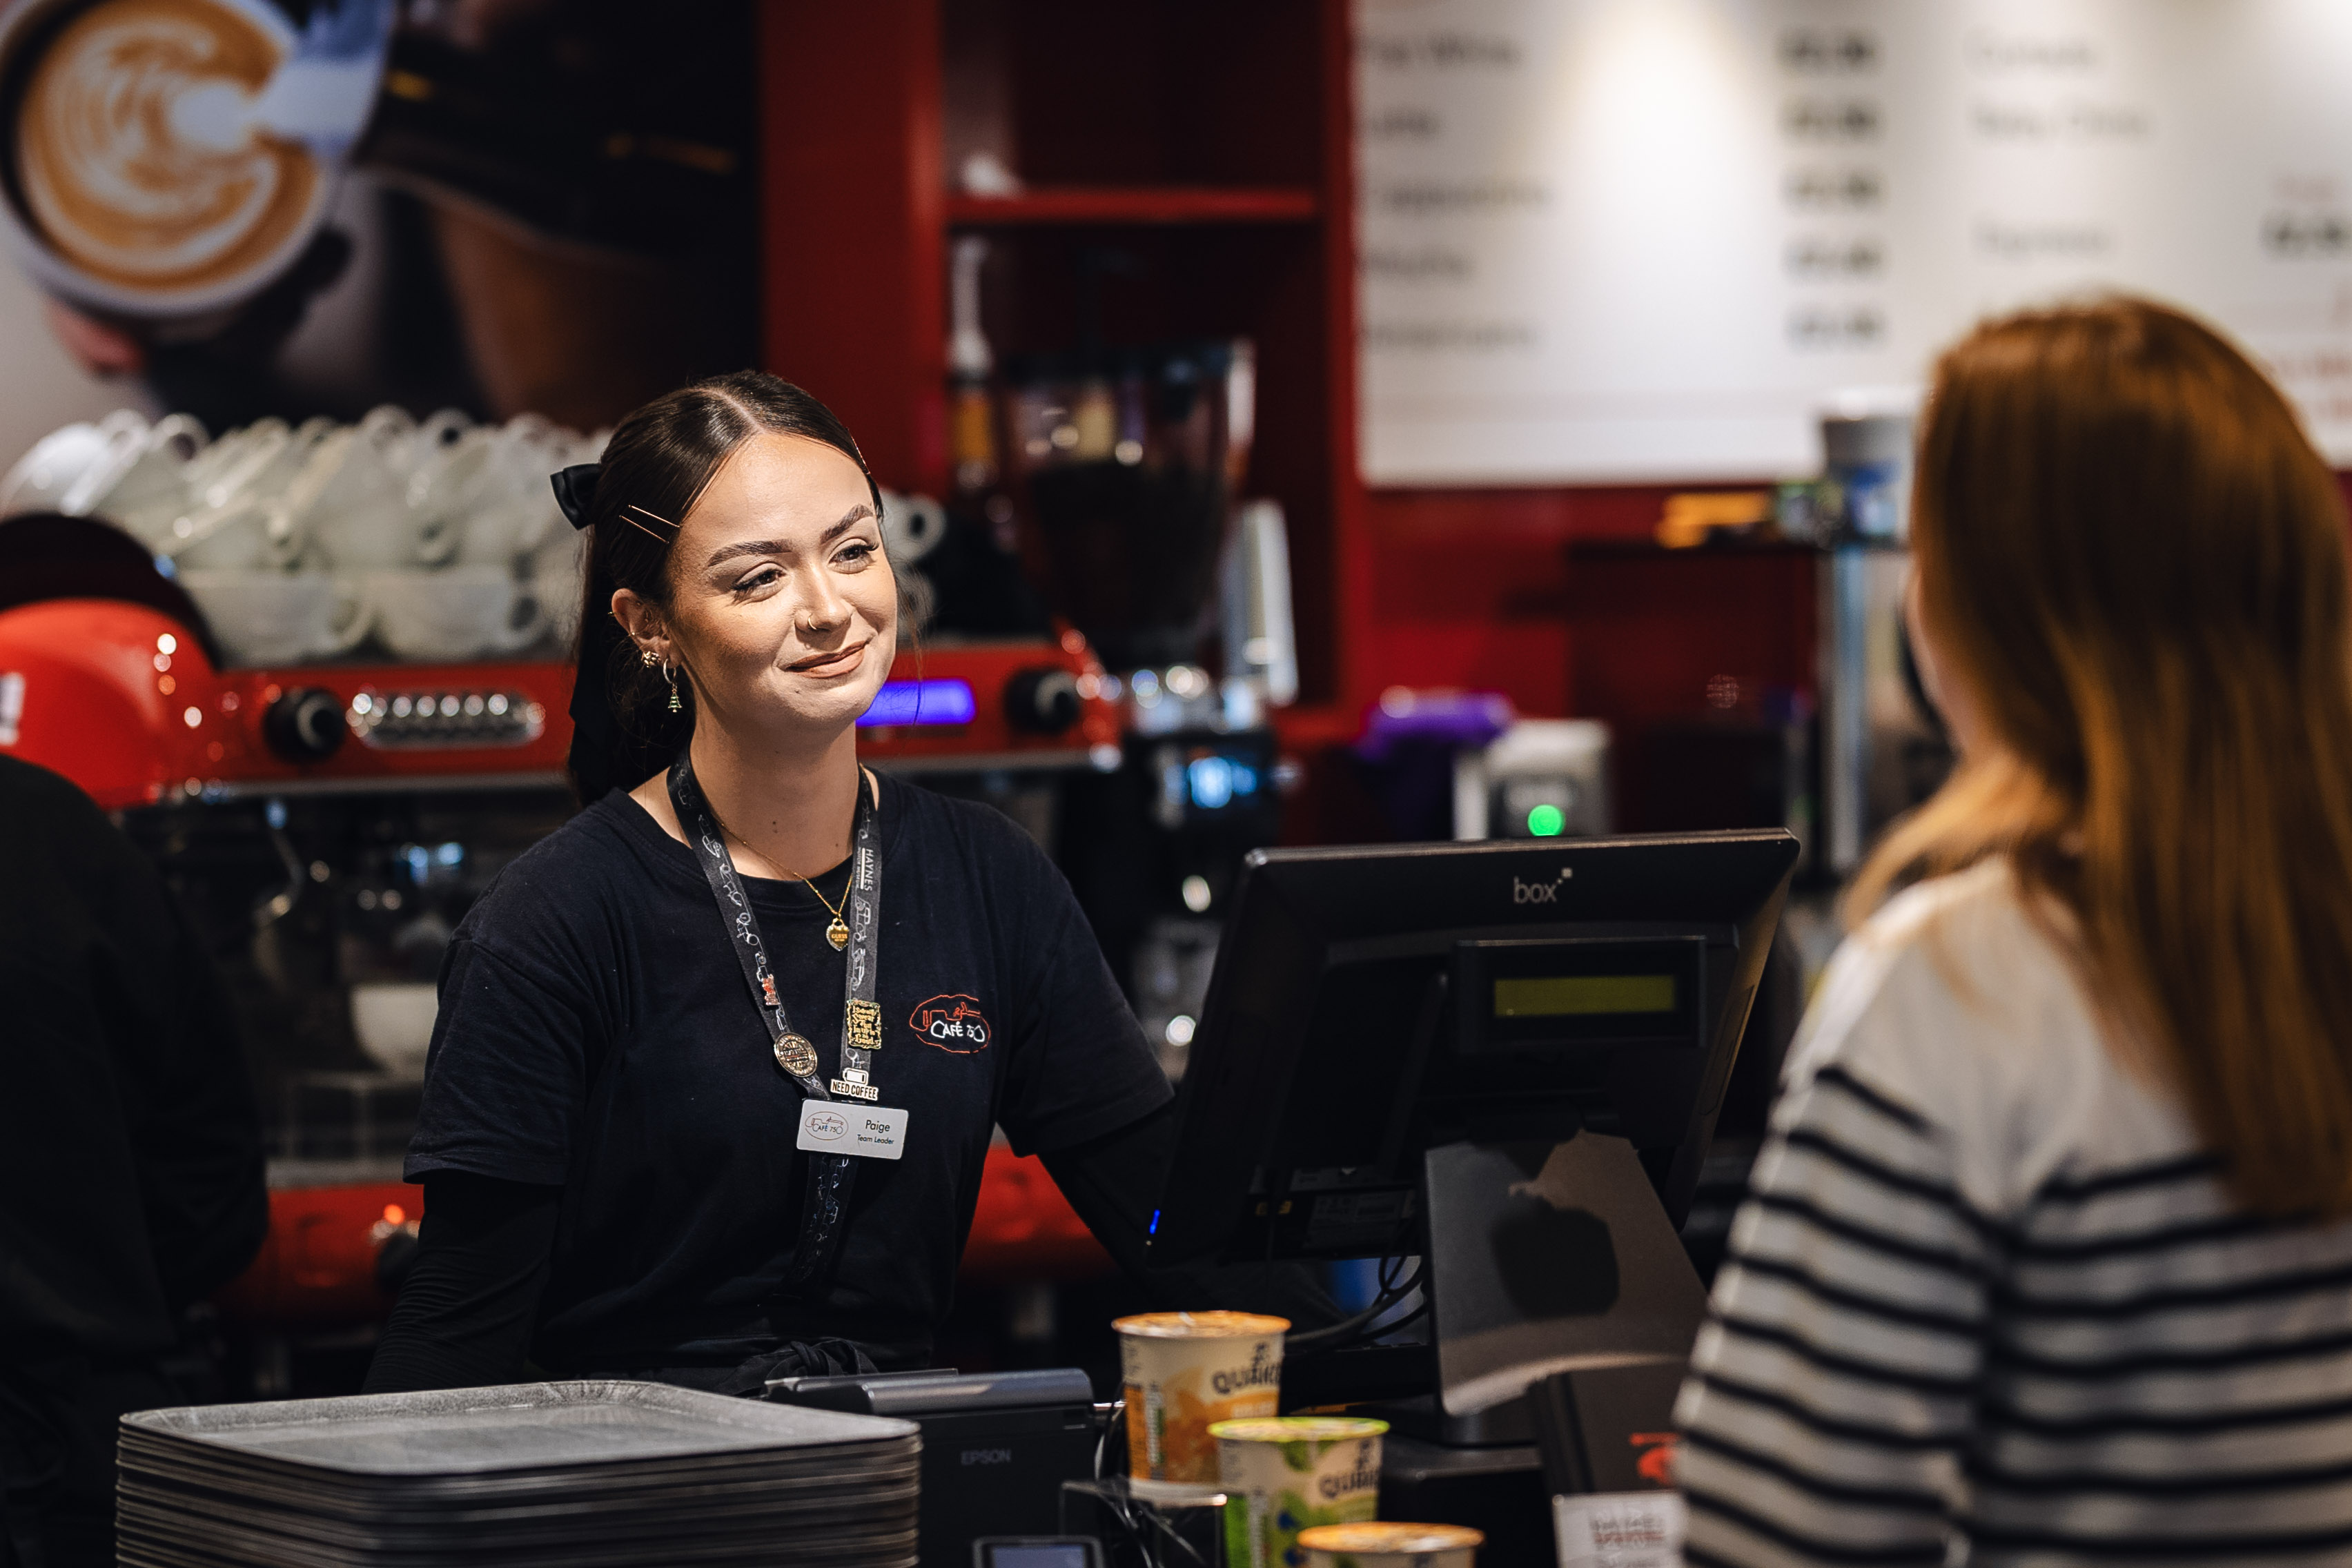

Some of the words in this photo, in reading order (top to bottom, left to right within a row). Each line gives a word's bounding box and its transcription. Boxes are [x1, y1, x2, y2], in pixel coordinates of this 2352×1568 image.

[864, 848, 874, 891] HAYNES
[1514, 876, 1557, 903] box
[832, 1081, 850, 1093] NEED
[851, 1084, 876, 1099] COFFEE
[865, 1119, 890, 1133] Paige
[857, 1134, 873, 1142] Team
[874, 1136, 894, 1145] Leader
[961, 1449, 1012, 1465] EPSON
